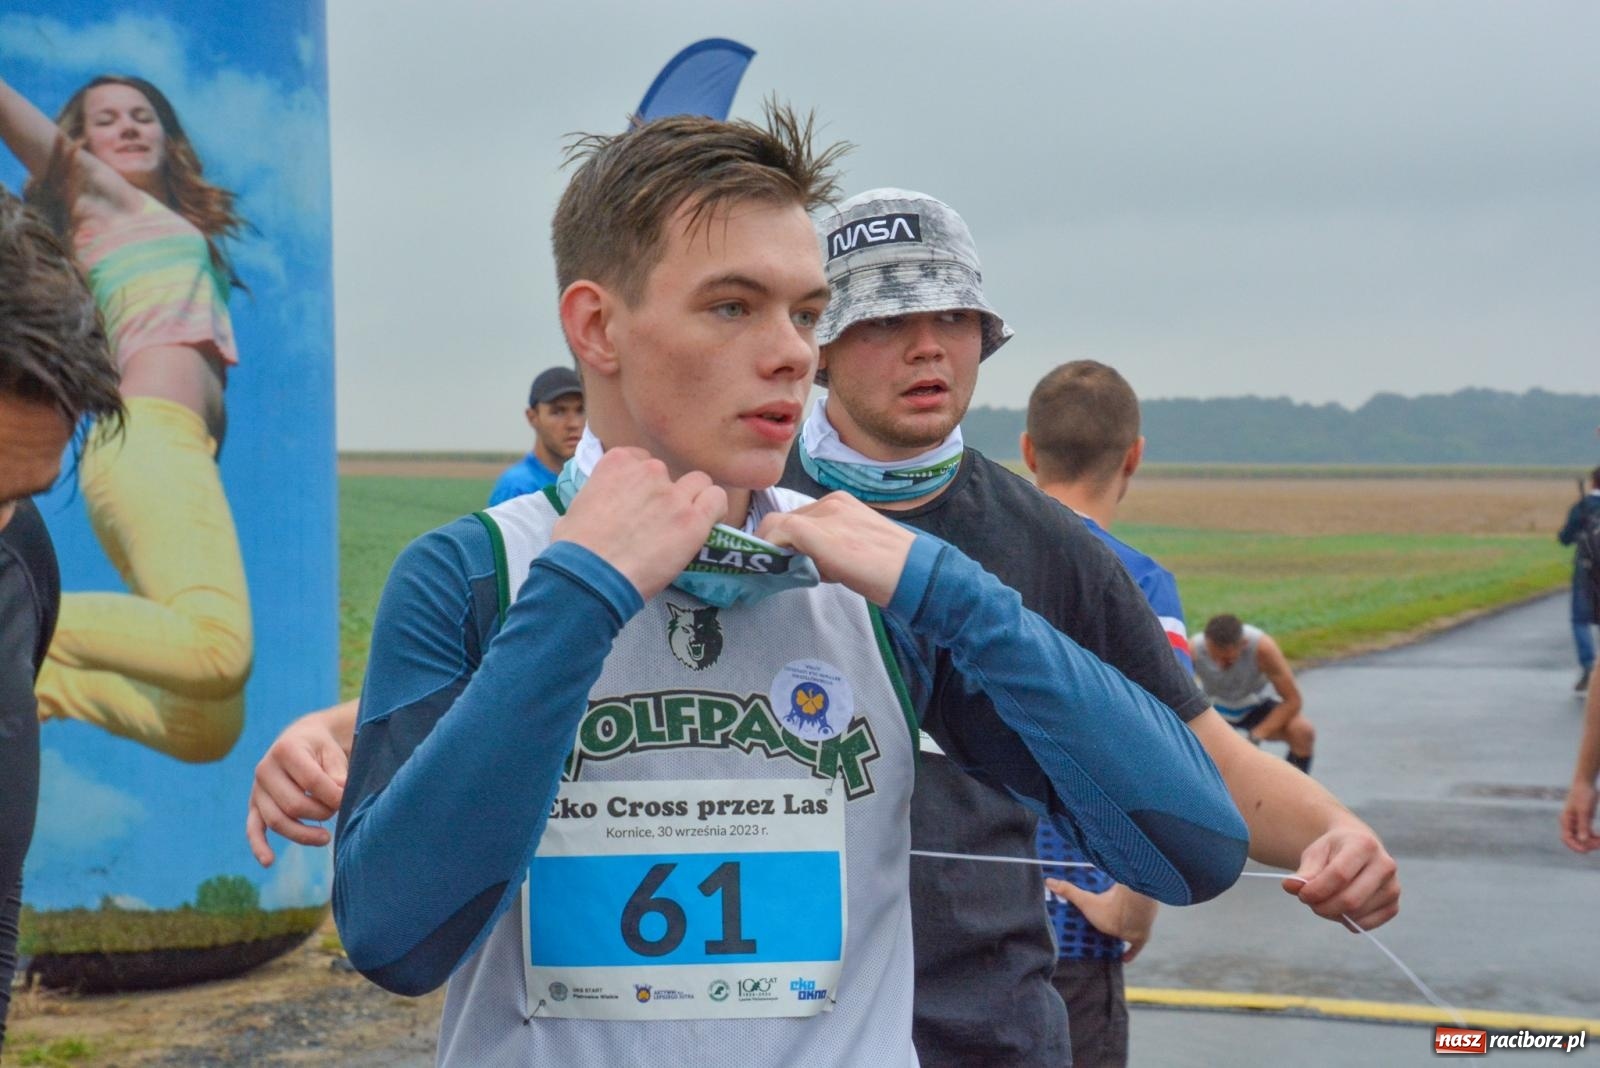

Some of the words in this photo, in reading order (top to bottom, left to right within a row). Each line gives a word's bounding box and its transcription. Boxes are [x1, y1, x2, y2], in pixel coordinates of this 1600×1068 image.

[833, 217, 915, 256] NASA
[700, 546, 773, 572] LAS
[563, 690, 880, 800] OLFPAK
[607, 796, 689, 818] Cross
[697, 799, 776, 821] przez
[783, 794, 829, 815] Las
[606, 827, 655, 839] Kornice,
[657, 826, 673, 837] 30
[675, 824, 727, 837] września
[729, 824, 760, 836] 2023
[761, 826, 769, 836] r.
[620, 861, 758, 957] 61
